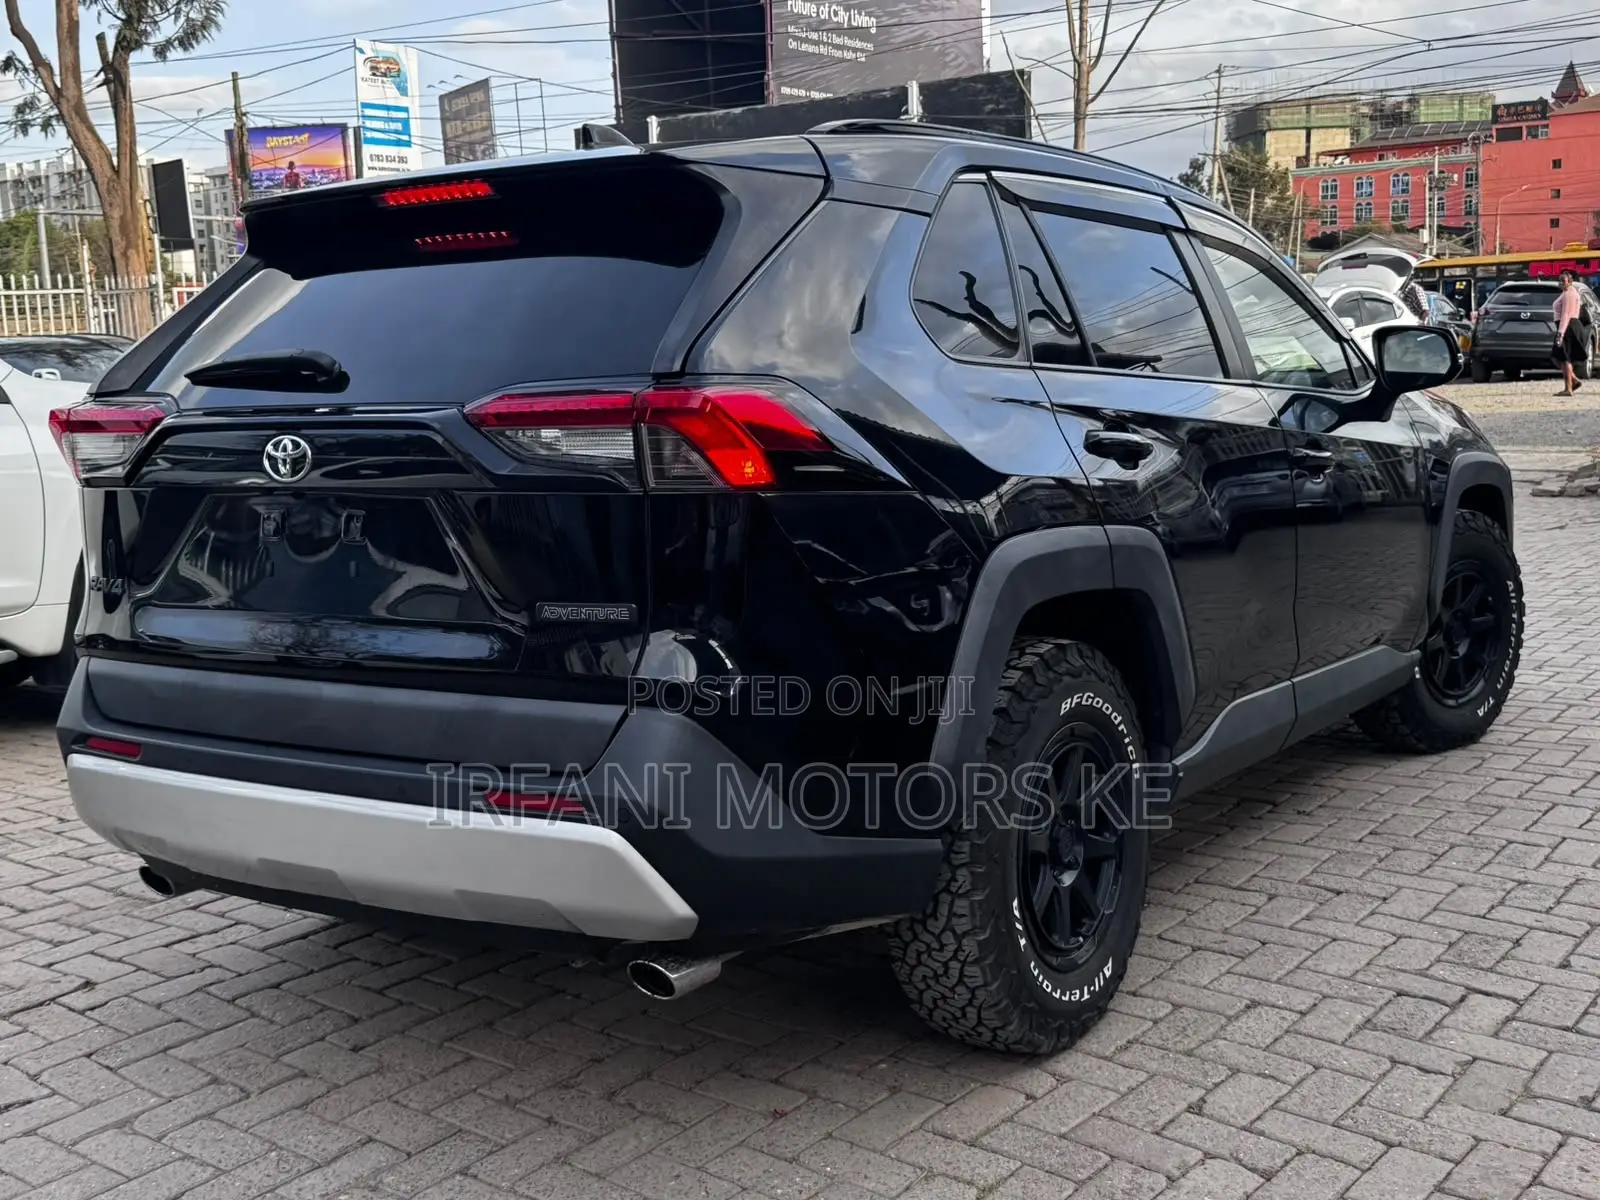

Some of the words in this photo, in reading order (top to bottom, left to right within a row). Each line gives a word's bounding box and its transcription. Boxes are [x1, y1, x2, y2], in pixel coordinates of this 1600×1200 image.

[819, 3, 829, 20] of
[830, 5, 849, 28] City
[851, 9, 877, 34] Living
[788, 38, 796, 49] On
[819, 44, 828, 55] Rd
[828, 46, 843, 58] From
[541, 605, 631, 621] ADVENTURE
[1060, 692, 1141, 780] BFGoodrich
[1012, 896, 1027, 952] T/A
[1030, 955, 1113, 1002] All-Terrain
